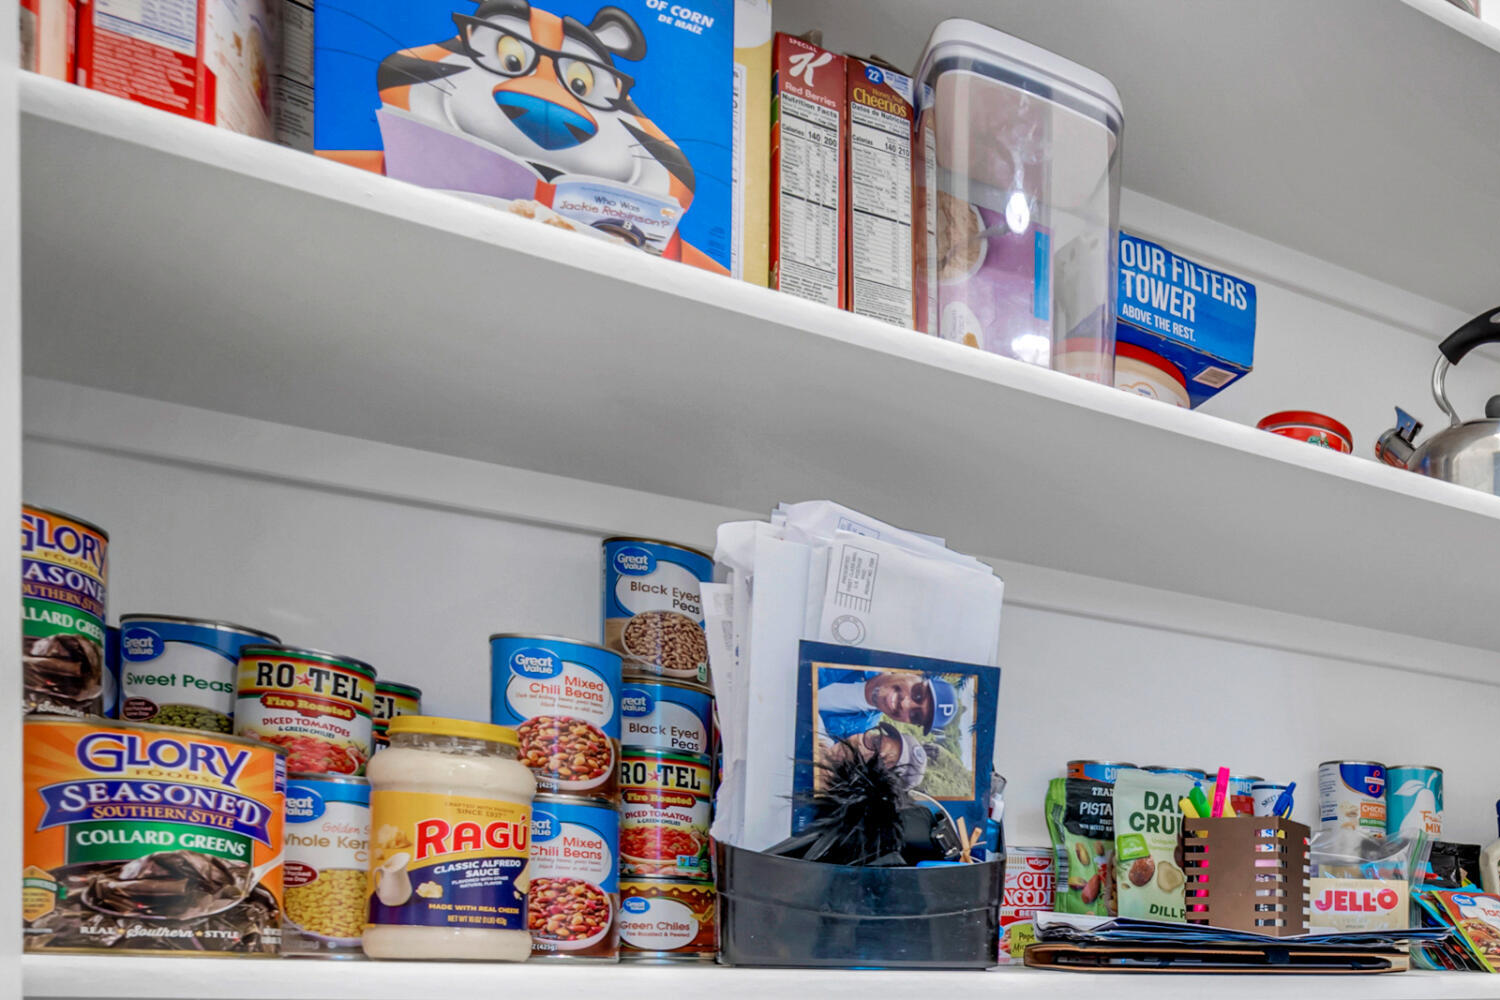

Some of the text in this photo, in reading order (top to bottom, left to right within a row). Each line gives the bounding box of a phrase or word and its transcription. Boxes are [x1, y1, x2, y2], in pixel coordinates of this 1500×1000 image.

[646, 0, 714, 27] OF CORN
[789, 52, 833, 87] K
[868, 68, 879, 82] 22
[785, 81, 836, 107] Red Berries
[853, 87, 907, 117] Cheerios
[1122, 239, 1248, 311] OUR FILTERS
[1124, 269, 1196, 322] TOWER
[1122, 304, 1196, 342] ABOVE THE REST.
[617, 553, 648, 565] Great
[623, 562, 648, 572] Value
[630, 581, 700, 604] Black Eyed
[672, 599, 700, 615] Peas
[124, 636, 153, 648] Great
[515, 654, 553, 668] Great
[522, 664, 553, 675] Value
[126, 672, 234, 694] Sweet Peas
[529, 682, 604, 703] Chili Beans
[564, 676, 604, 692] Mixed
[262, 717, 351, 738] DICED TOMATOES
[629, 723, 699, 741] Black Eyed
[671, 738, 699, 751] Peas
[76, 733, 251, 790] GLORY
[60, 783, 261, 825] SEASONED
[92, 806, 234, 829] SOUTHERN STYLE
[625, 809, 693, 823] DICED TOMATOES
[322, 823, 360, 835] Golden
[414, 814, 528, 862] RAGÚ
[76, 829, 246, 857] COLLARD GREENS
[562, 836, 602, 850] Mixed
[433, 860, 479, 874] CLASSIC
[482, 859, 521, 867] ALFREDO
[466, 869, 500, 877] SAUCE
[1150, 904, 1177, 918] DILL
